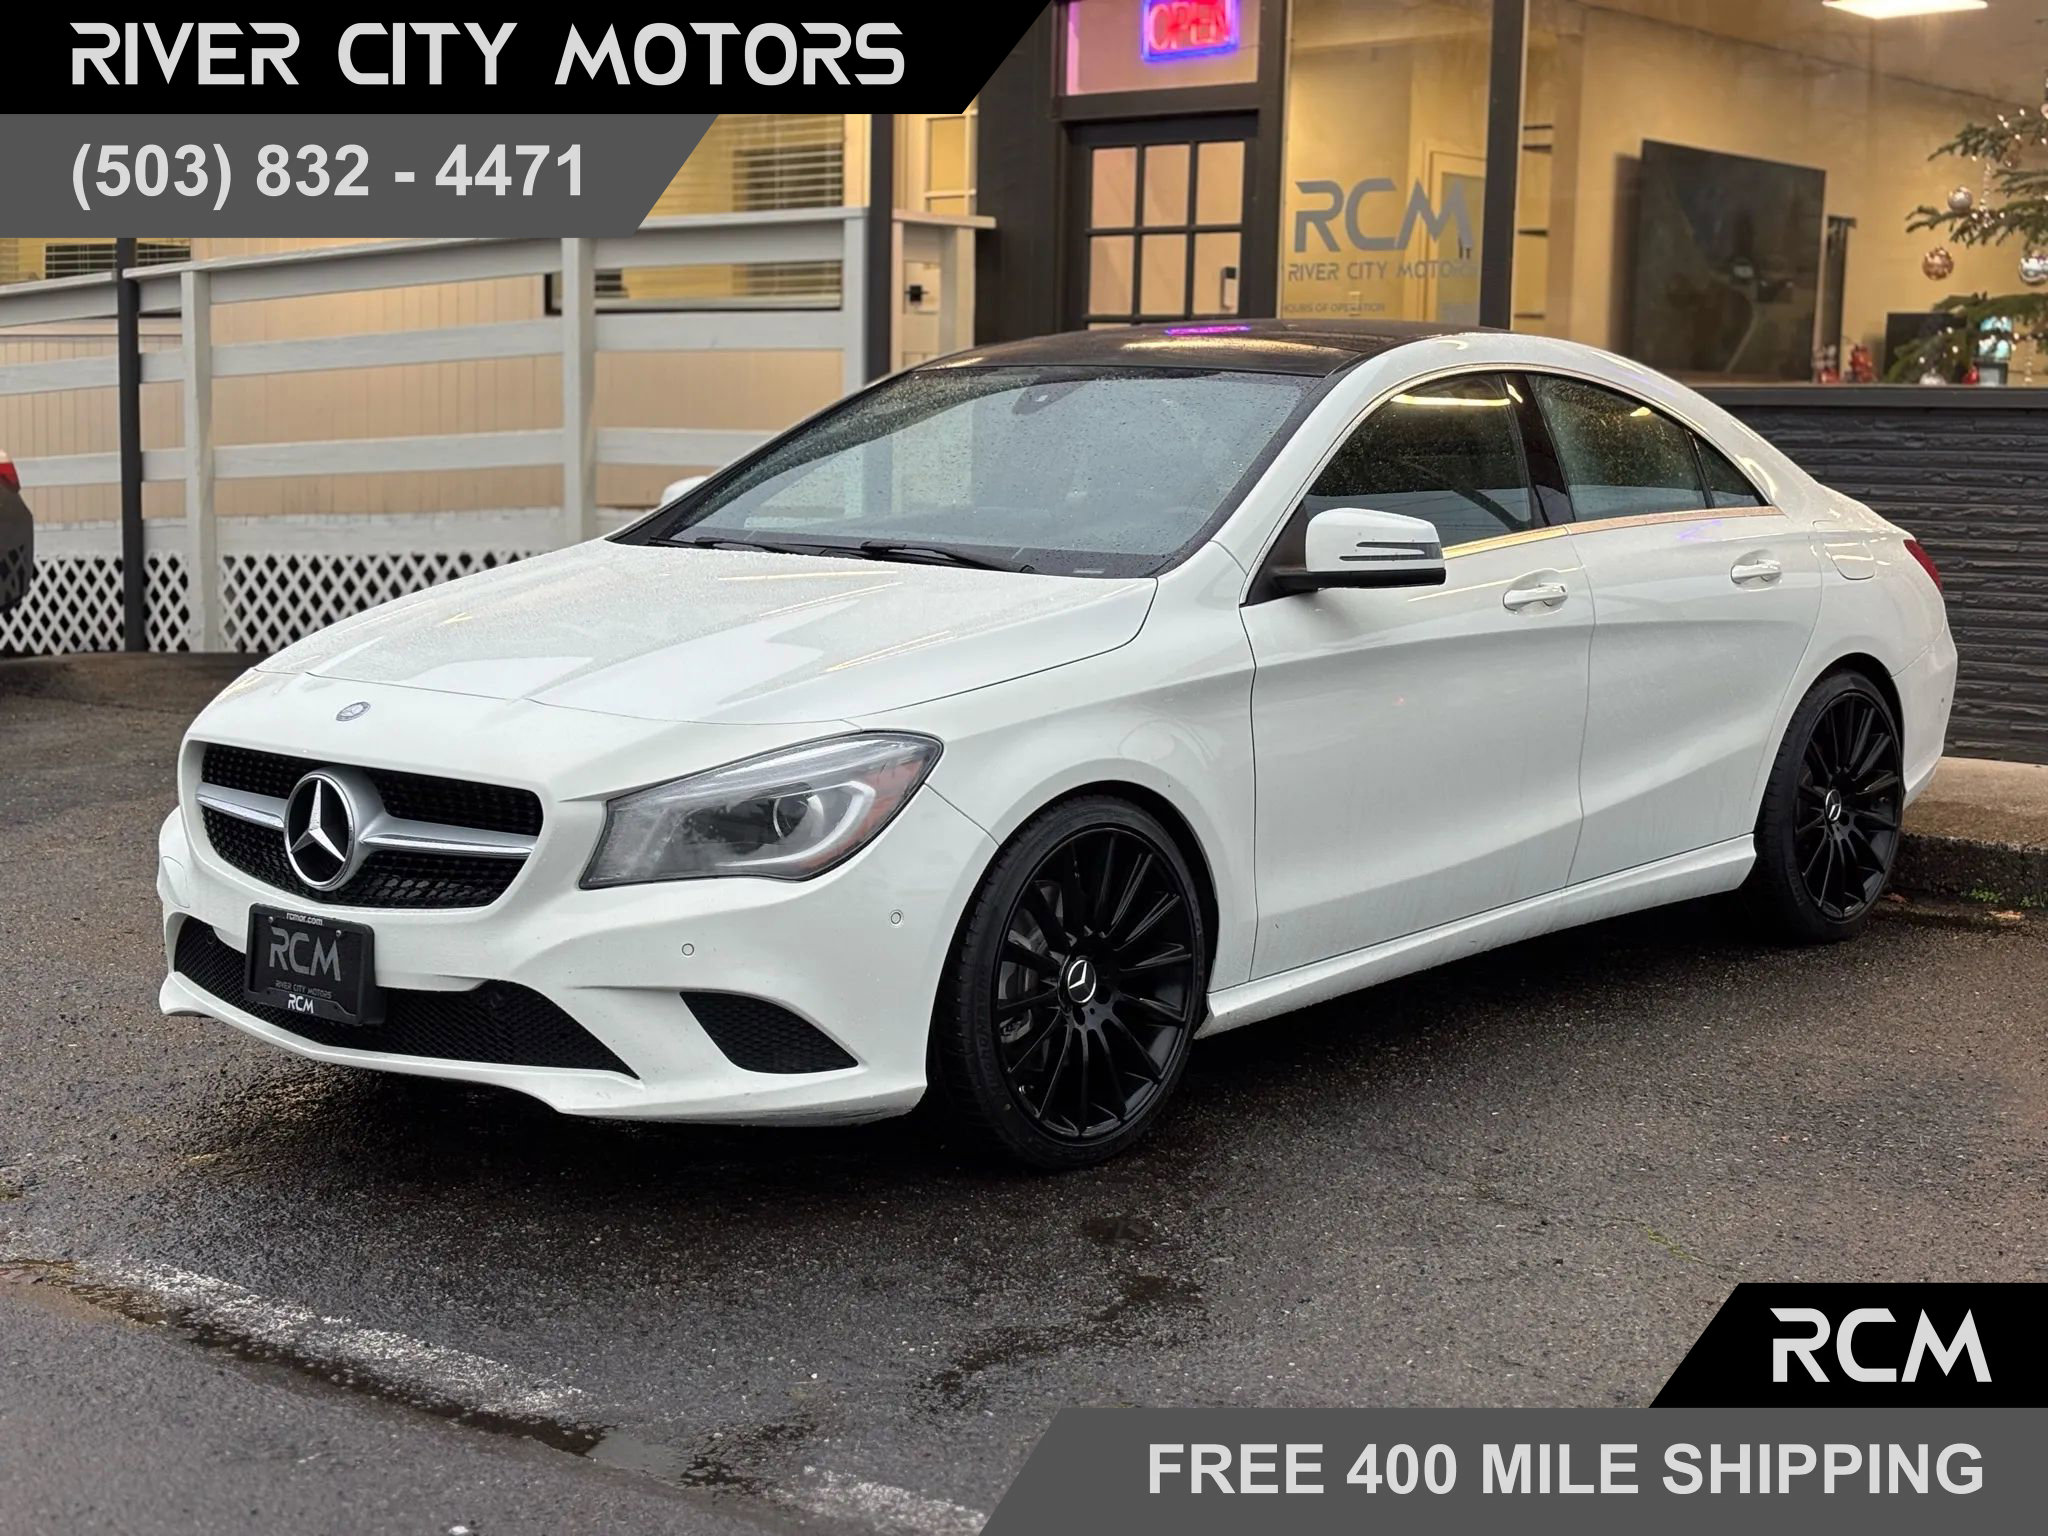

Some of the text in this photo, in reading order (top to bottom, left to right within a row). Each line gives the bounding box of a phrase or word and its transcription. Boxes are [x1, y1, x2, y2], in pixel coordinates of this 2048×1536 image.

[1149, 0, 1231, 50] OPEN
[1294, 177, 1475, 252] RCM
[1288, 262, 1340, 281] RIVER
[1346, 260, 1388, 280] CITY
[269, 926, 341, 982] RCM
[287, 993, 314, 1014] RCM
[292, 984, 306, 993] CITY
